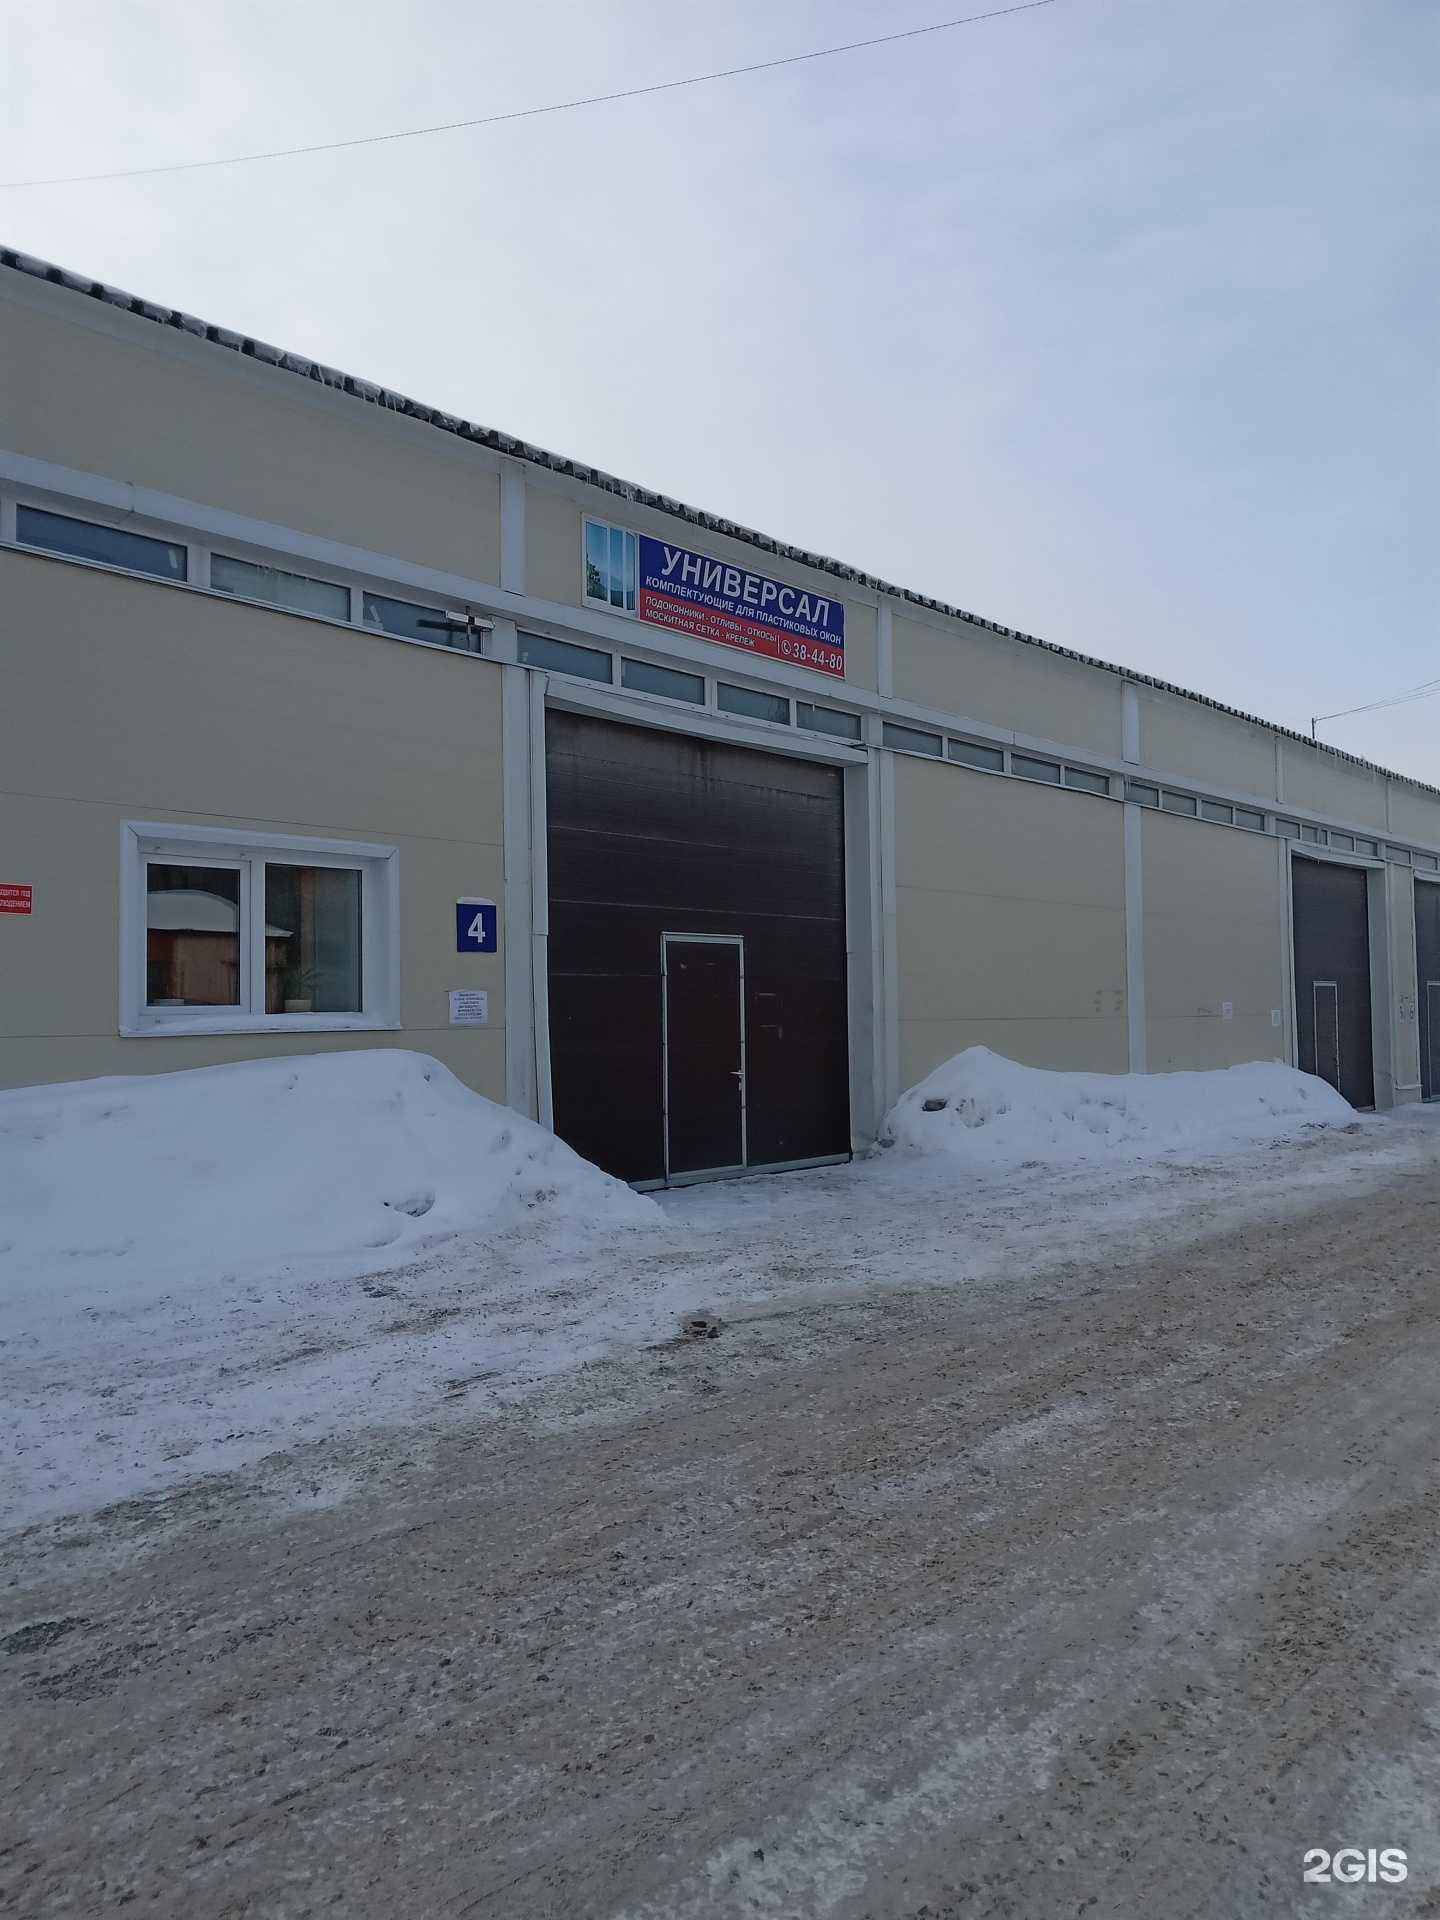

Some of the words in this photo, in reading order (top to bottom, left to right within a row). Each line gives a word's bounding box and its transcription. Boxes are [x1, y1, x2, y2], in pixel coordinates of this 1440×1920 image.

[661, 547, 829, 626] УНИВЕРСАЛ
[645, 576, 734, 612] КОМПЛЕКТУЮЩИЕ
[735, 604, 754, 618] ДЛЯ
[755, 611, 819, 638] ПЛАСТИКОВЫХ
[819, 631, 842, 645] ОКОН
[645, 596, 705, 620] ПОДОКОННИКИ
[710, 615, 742, 631] ОТЛИВЫ
[748, 627, 777, 642] ОТКОСЫ
[645, 609, 695, 630] МОСКИТНАЯ
[696, 623, 720, 637] СЕТКА
[793, 642, 843, 670] 38-44-80
[467, 912, 486, 943] 4
